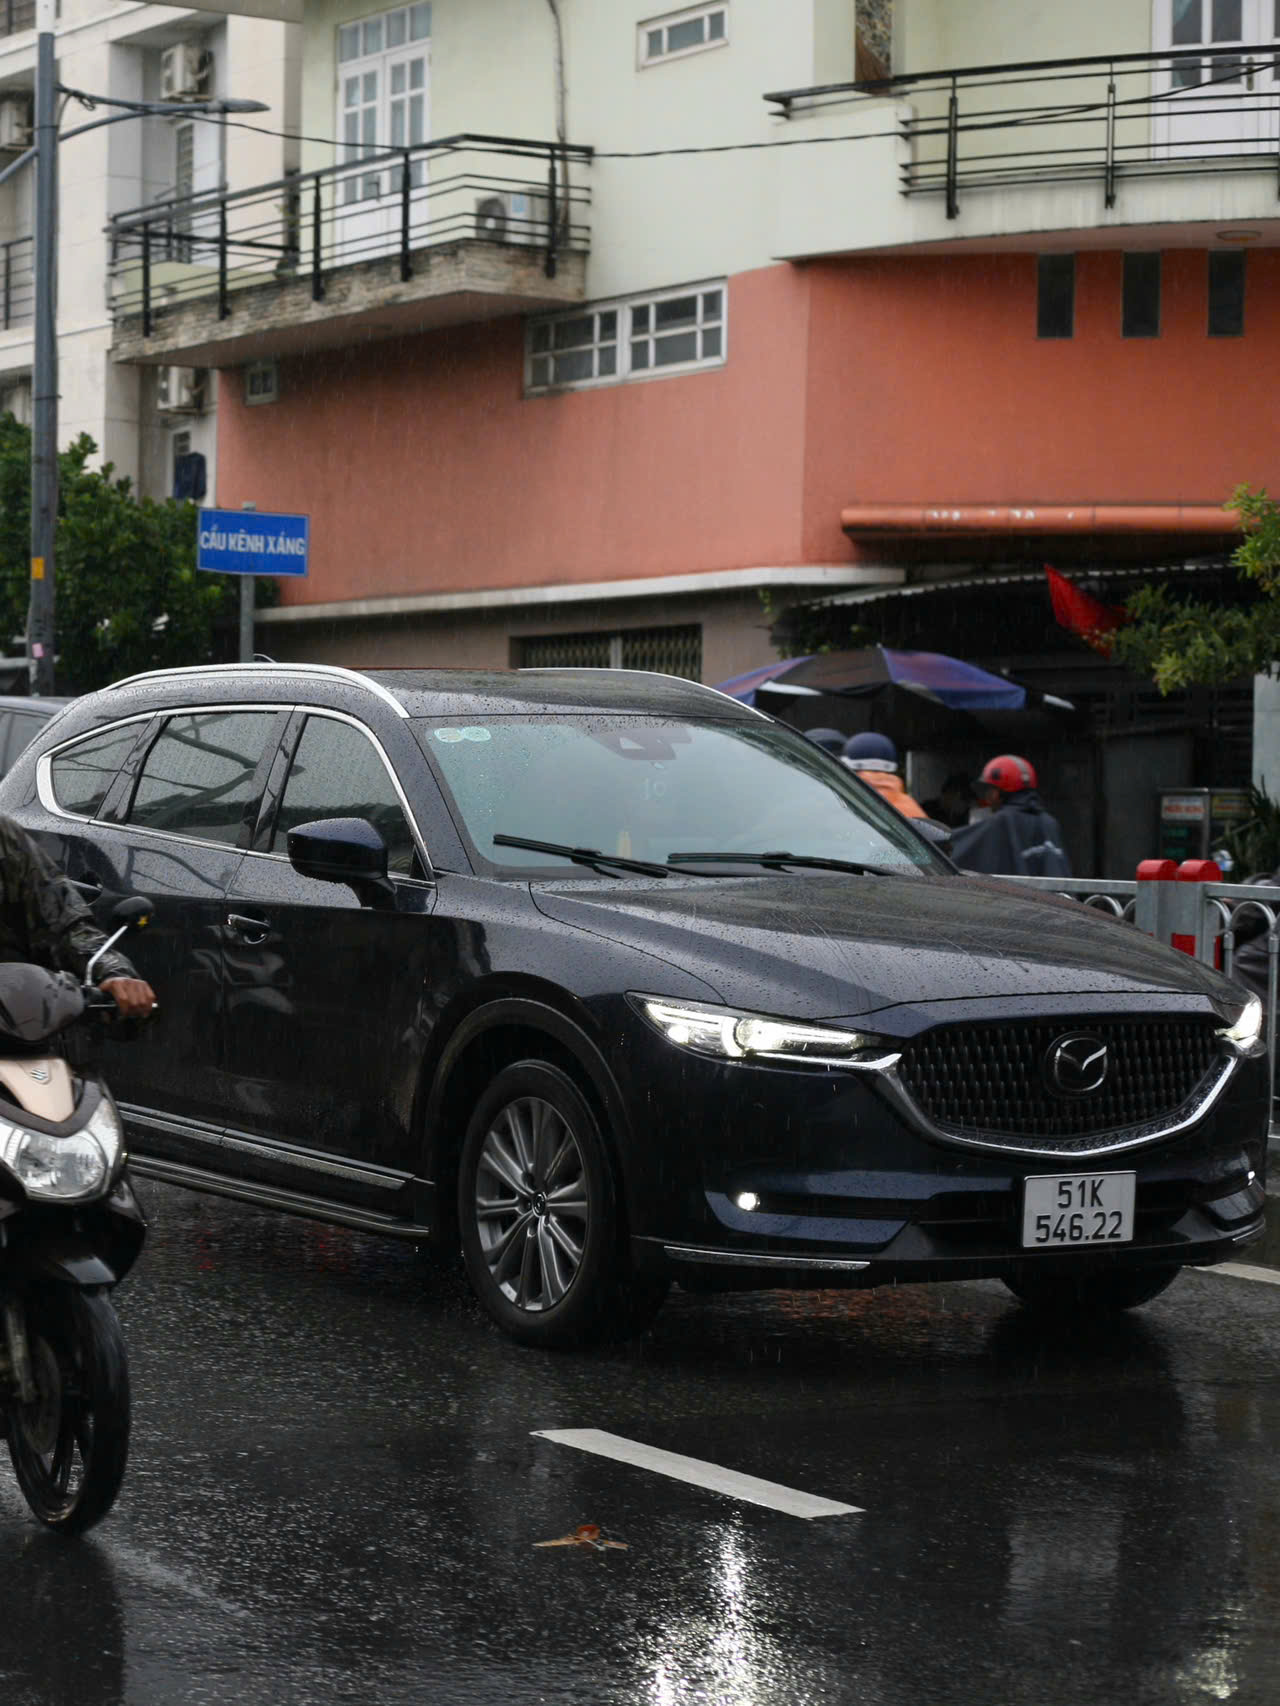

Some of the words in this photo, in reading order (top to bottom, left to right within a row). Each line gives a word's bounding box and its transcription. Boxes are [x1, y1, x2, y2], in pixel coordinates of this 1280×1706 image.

[228, 528, 265, 554] KÊNH
[266, 530, 305, 556] XÁNG
[1057, 1179, 1104, 1209] 51K
[1034, 1210, 1123, 1243] 546.22
